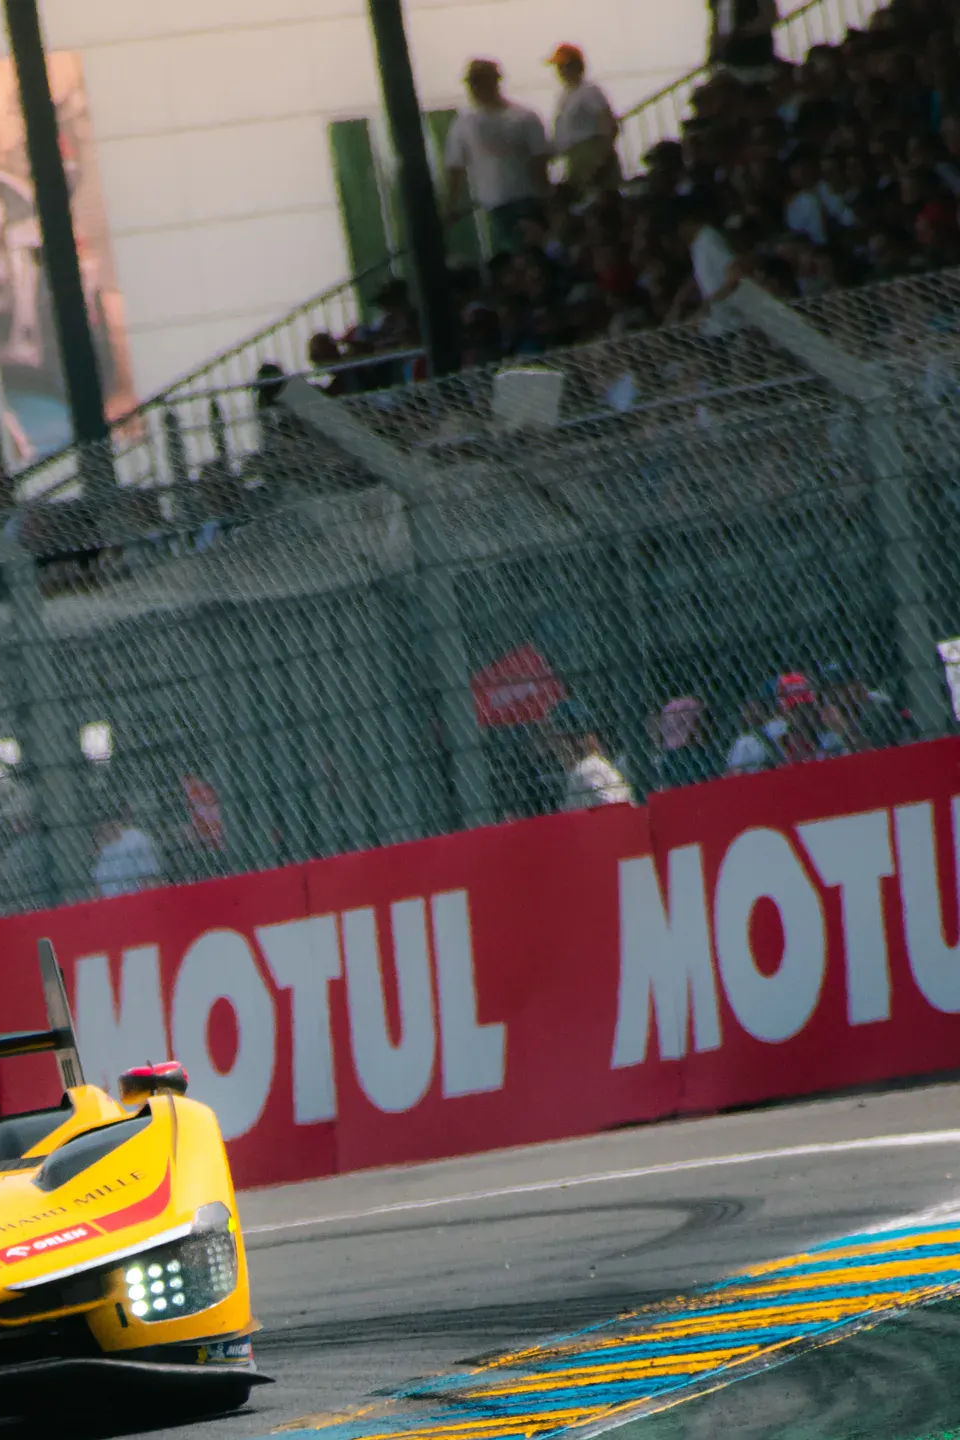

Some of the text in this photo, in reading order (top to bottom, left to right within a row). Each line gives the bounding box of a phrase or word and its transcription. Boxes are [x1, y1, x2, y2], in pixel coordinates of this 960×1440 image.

[74, 888, 508, 1141] MOTUL
[73, 1170, 147, 1207] MILLE
[32, 1227, 89, 1250] ORLEN
